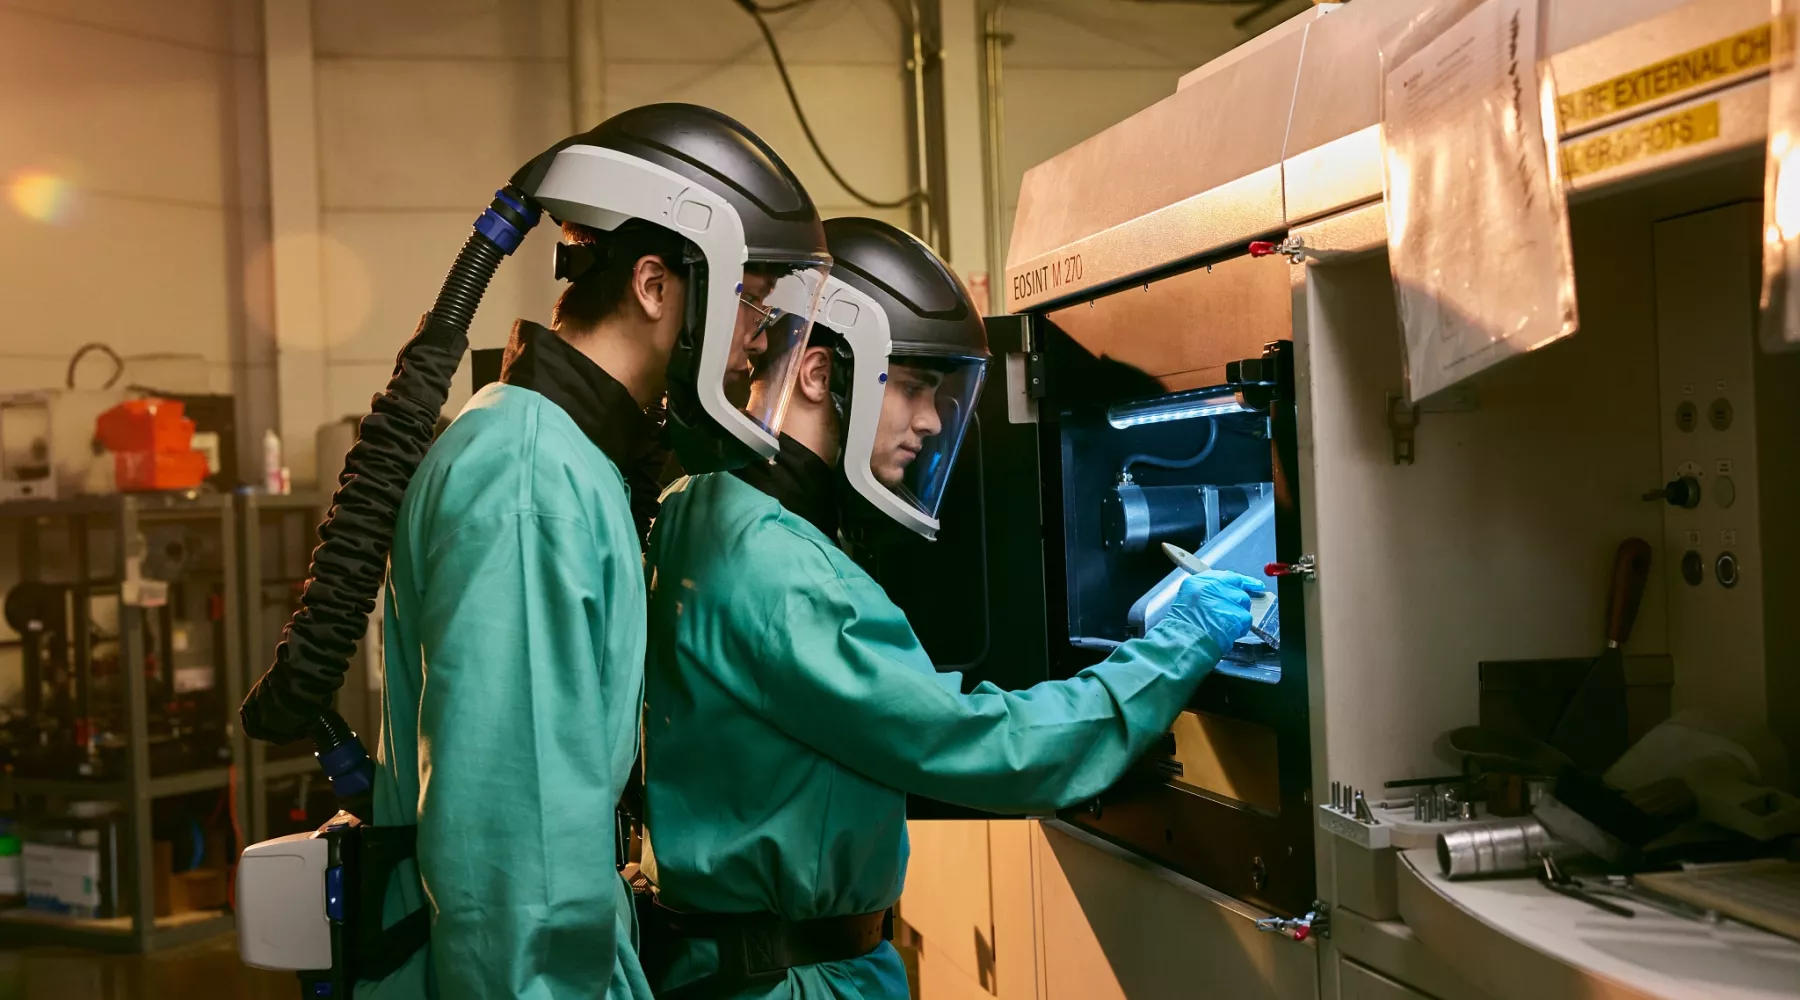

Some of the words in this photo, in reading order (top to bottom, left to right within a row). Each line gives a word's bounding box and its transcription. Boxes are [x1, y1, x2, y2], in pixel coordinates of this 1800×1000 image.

[1614, 47, 1728, 107] EXTERNAL
[1013, 265, 1048, 300] EOSINT
[1052, 260, 1062, 288] M
[1064, 253, 1083, 284] 270
